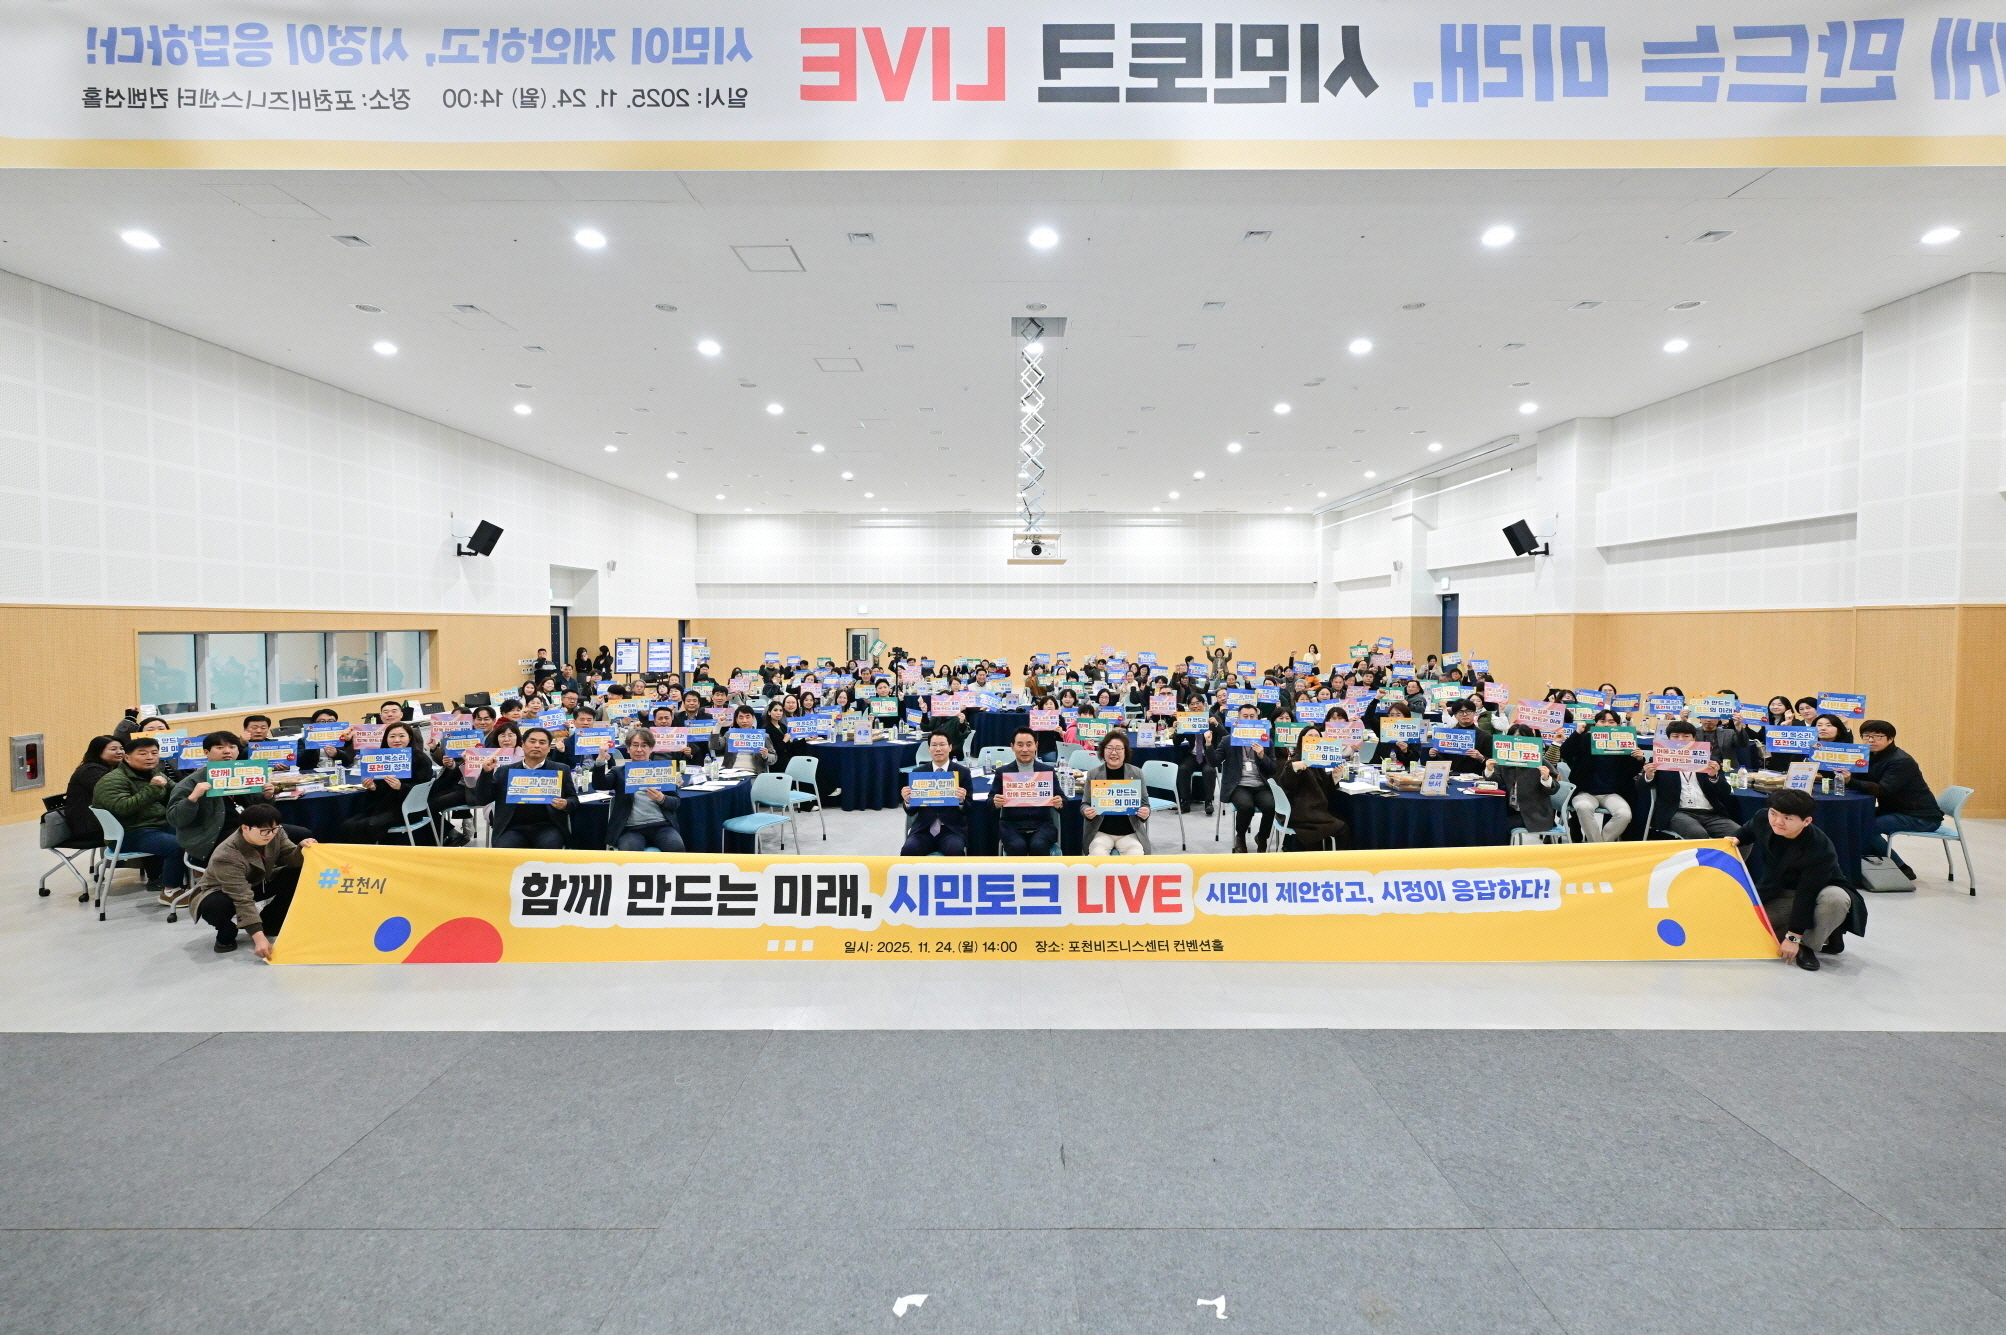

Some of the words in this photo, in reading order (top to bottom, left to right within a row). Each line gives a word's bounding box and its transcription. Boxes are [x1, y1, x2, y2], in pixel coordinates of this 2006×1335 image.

[1820, 701, 1861, 711] 시민토크
[1233, 729, 1265, 737] 시민토크
[1593, 732, 1609, 740] 함께
[1767, 730, 1788, 738] 시민의
[1789, 731, 1813, 739] 목소리,
[1440, 740, 1458, 748] 포천의
[1515, 742, 1538, 751] 만드는
[1773, 739, 1797, 747] 포천의
[252, 750, 293, 760] 시민토크
[362, 755, 384, 763] 시민의
[385, 754, 408, 762] 목소리,
[1308, 753, 1328, 761] 포천의
[1523, 752, 1540, 761] 포천
[1813, 751, 1864, 764] 시민토크
[368, 764, 392, 772] 포천의
[394, 763, 410, 771] 정책
[210, 769, 231, 778] 함께
[235, 767, 263, 775] 만드는
[629, 769, 654, 777] 시민과
[655, 768, 672, 776] 함께
[244, 777, 264, 786] 포천
[512, 777, 538, 786] 시민과
[540, 777, 557, 785] 함께
[913, 779, 937, 788] 시민과
[938, 779, 955, 788] 함께
[1791, 781, 1807, 789] 부서
[1093, 788, 1115, 796] 우리가
[1099, 799, 1123, 807] 포천의
[1125, 799, 1140, 807] 미래
[522, 873, 613, 917] 함께
[627, 875, 760, 917] 만드는
[774, 875, 873, 920] 미래,
[889, 874, 1064, 918] 시민토크
[1078, 875, 1184, 915] LIVE
[1206, 883, 1269, 905] 시민이
[1276, 881, 1376, 907] 제안하고,
[1382, 880, 1447, 904] 시정이
[1452, 878, 1553, 904] 응답하다!
[843, 940, 873, 954] 일시:
[876, 941, 913, 954] 2025.
[918, 942, 931, 954] 11.
[935, 942, 955, 954] 24.
[958, 941, 978, 954] (월)
[982, 942, 1018, 954] 14:00
[1035, 941, 1064, 954] 장소:
[1068, 940, 1170, 954] 포천비즈니스센터
[1173, 938, 1225, 954] 컨벤션홀
